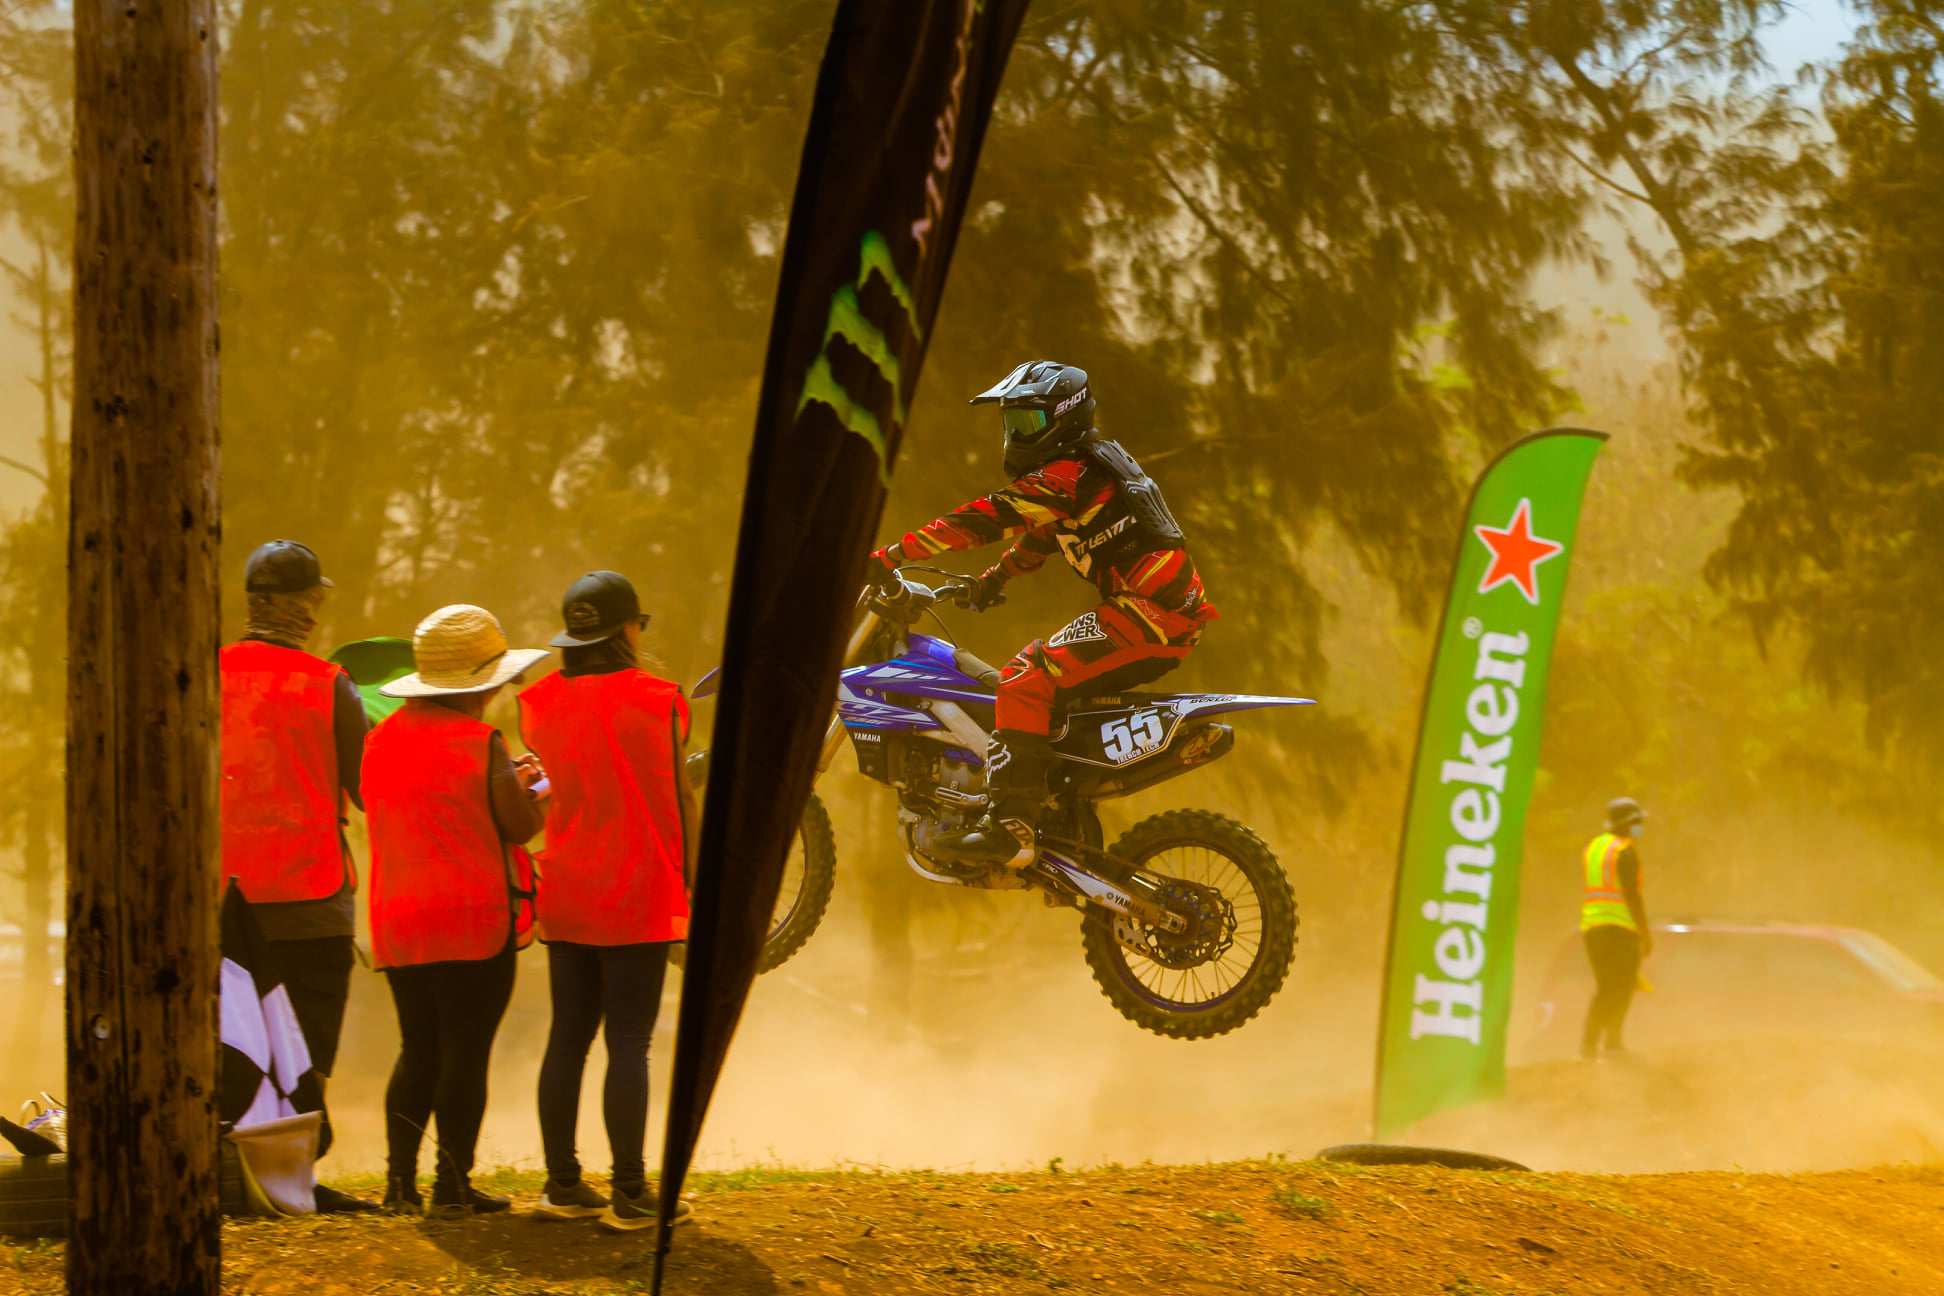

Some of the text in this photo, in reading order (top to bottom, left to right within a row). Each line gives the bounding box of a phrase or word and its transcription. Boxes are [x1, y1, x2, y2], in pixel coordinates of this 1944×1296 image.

[1054, 387, 1087, 415] SHOT
[853, 732, 881, 743] YAMAHA
[1101, 708, 1164, 761] 55
[1409, 631, 1530, 1046] Heineken
[1114, 895, 1147, 915] YAMAHA
